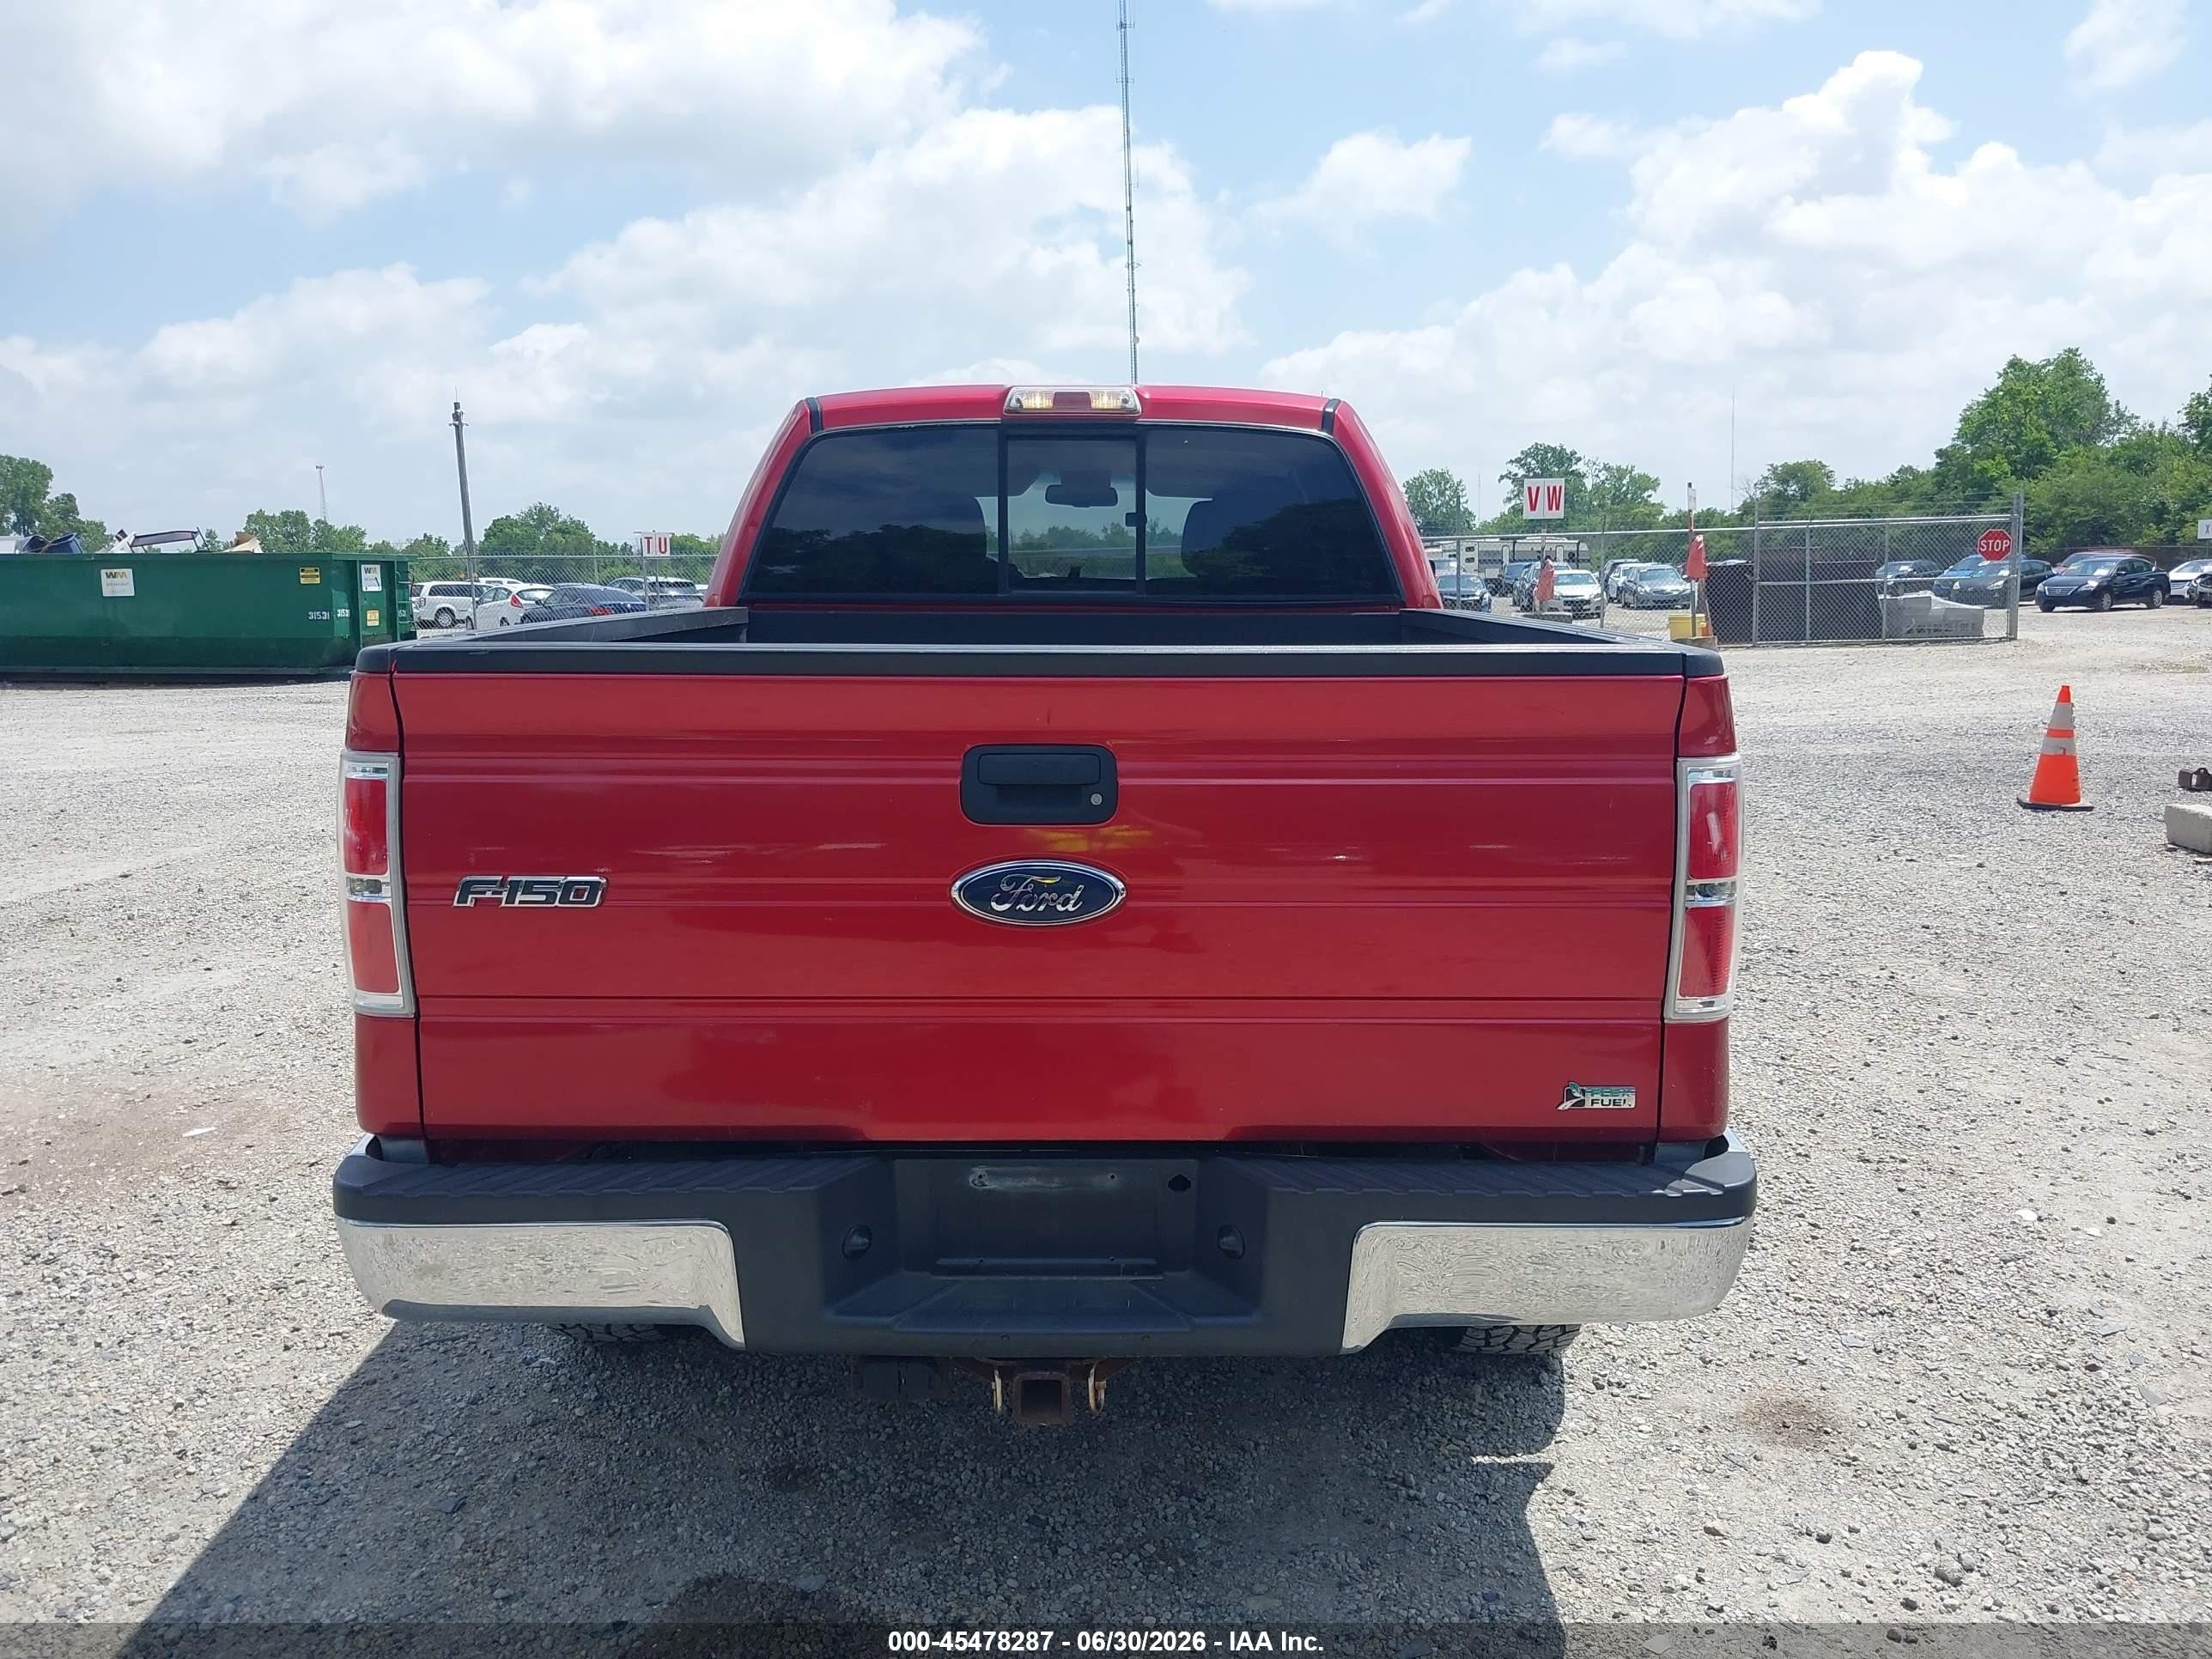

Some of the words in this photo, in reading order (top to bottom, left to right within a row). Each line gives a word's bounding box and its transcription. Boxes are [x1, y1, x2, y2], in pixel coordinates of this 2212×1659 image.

[1979, 539, 2010, 552] STOP
[308, 611, 331, 620] 31531
[453, 875, 608, 908] F-150
[990, 874, 1085, 911] Ford
